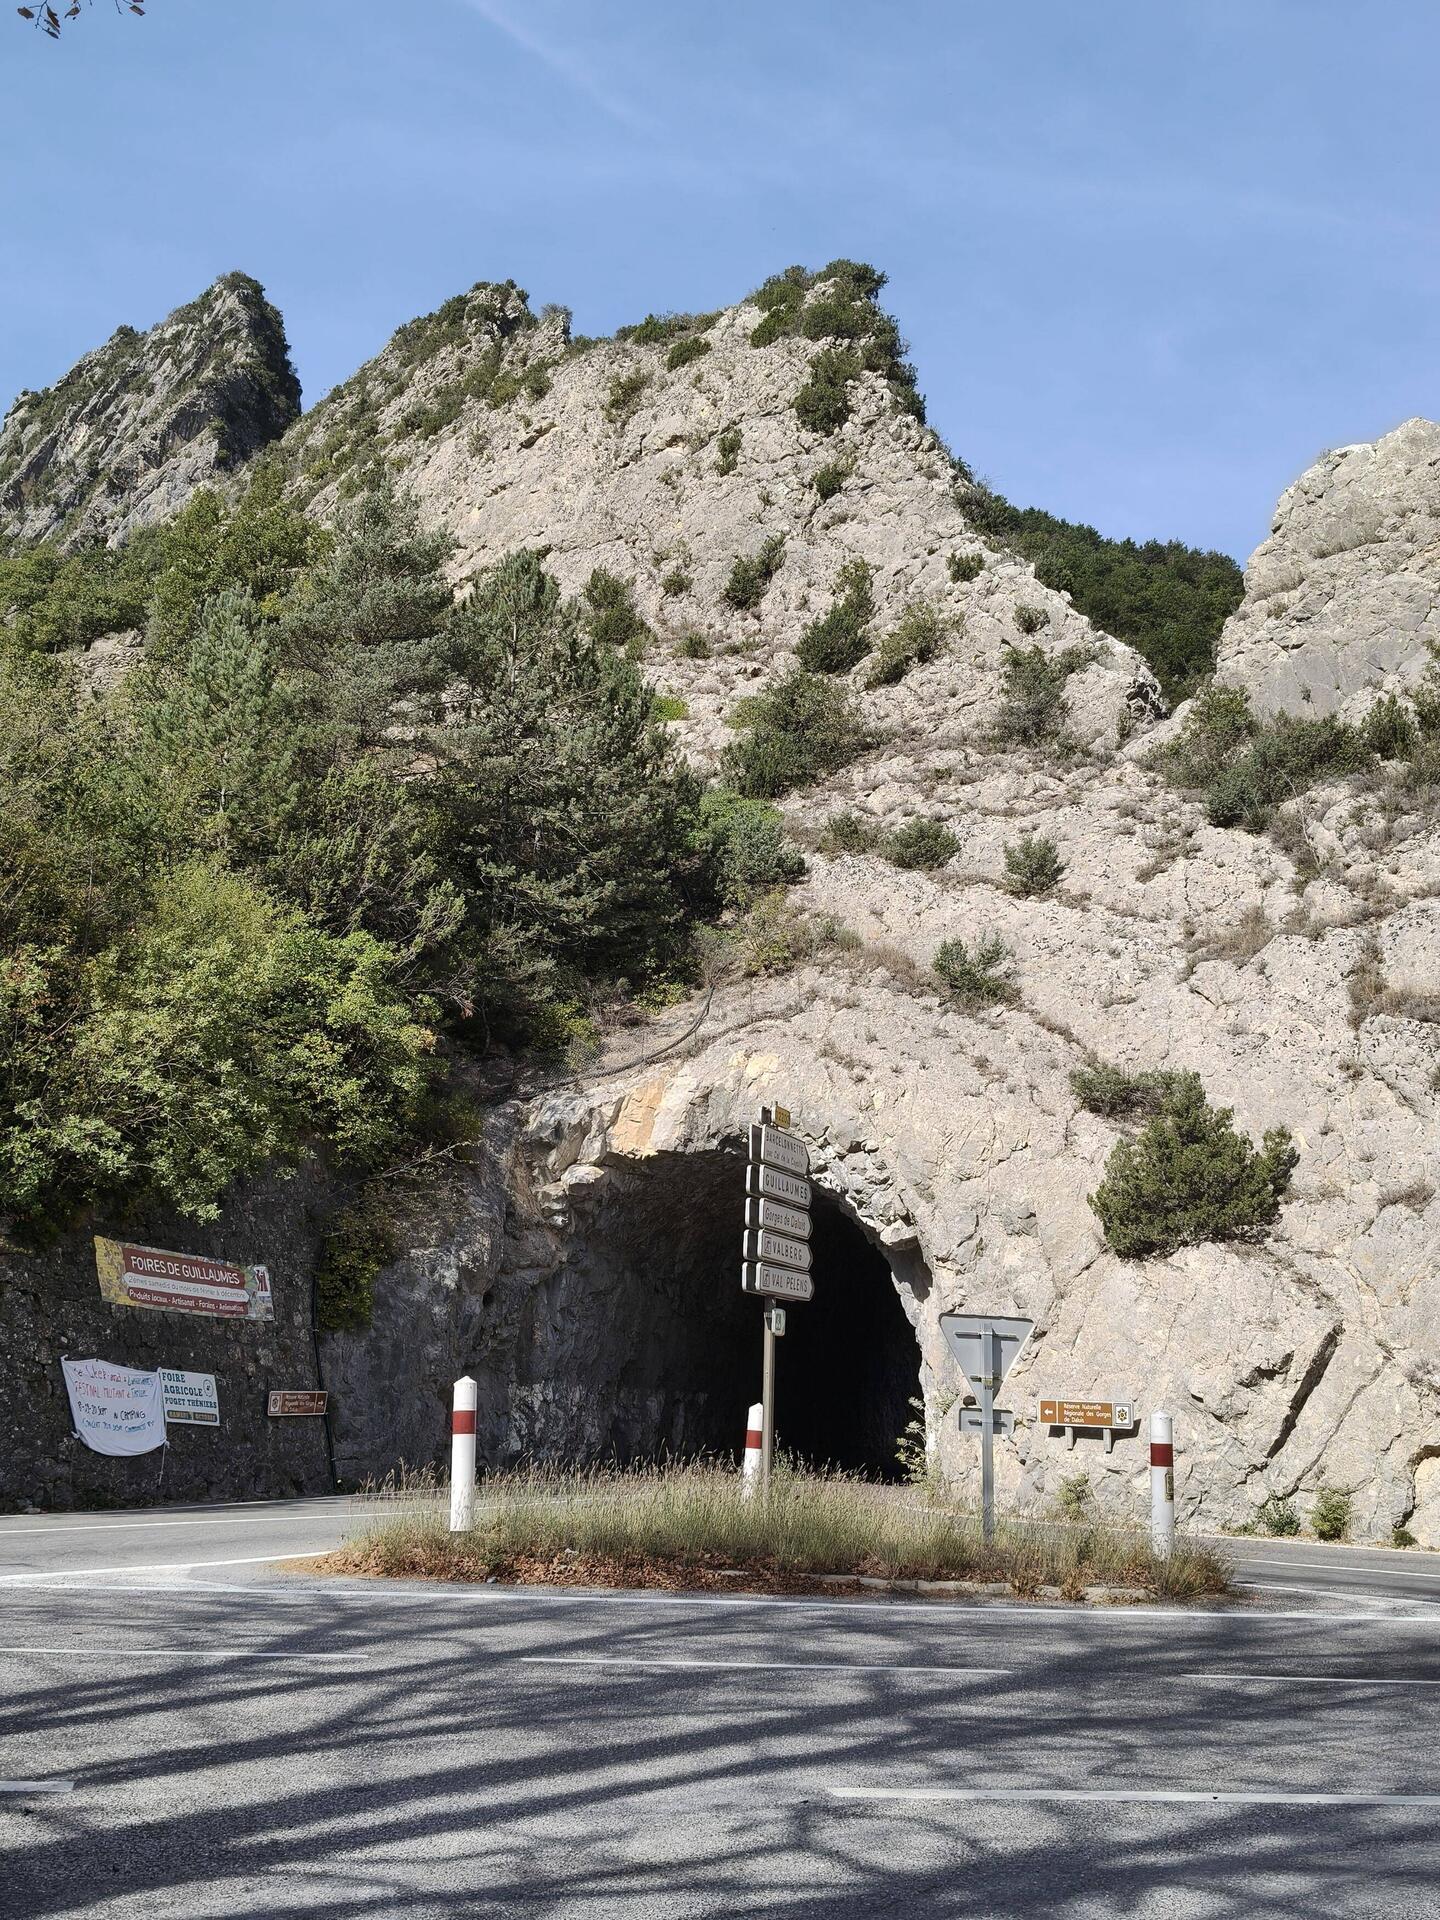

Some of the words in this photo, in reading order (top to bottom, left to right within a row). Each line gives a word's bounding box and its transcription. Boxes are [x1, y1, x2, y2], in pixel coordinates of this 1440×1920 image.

[766, 1174, 807, 1200] GUILLAUMES
[766, 1207, 783, 1226] Gorges
[784, 1213, 790, 1226] de
[791, 1216, 806, 1231] Daluis
[773, 1240, 802, 1261] VALBERG
[131, 1256, 166, 1273] FOIRES
[167, 1262, 181, 1276] DE
[182, 1265, 240, 1285] GUILLAUMES
[772, 1273, 783, 1288] VAL
[786, 1276, 808, 1293] PELENS
[129, 1289, 151, 1301] Produits
[151, 1293, 168, 1303] locaux
[172, 1297, 195, 1307] Artisanat
[162, 1372, 186, 1383] FOIRE
[164, 1385, 203, 1397] AGRICOLE
[165, 1397, 186, 1406] PUGET
[187, 1398, 217, 1409] THÉNIERS
[1095, 1411, 1111, 1419] Gorges
